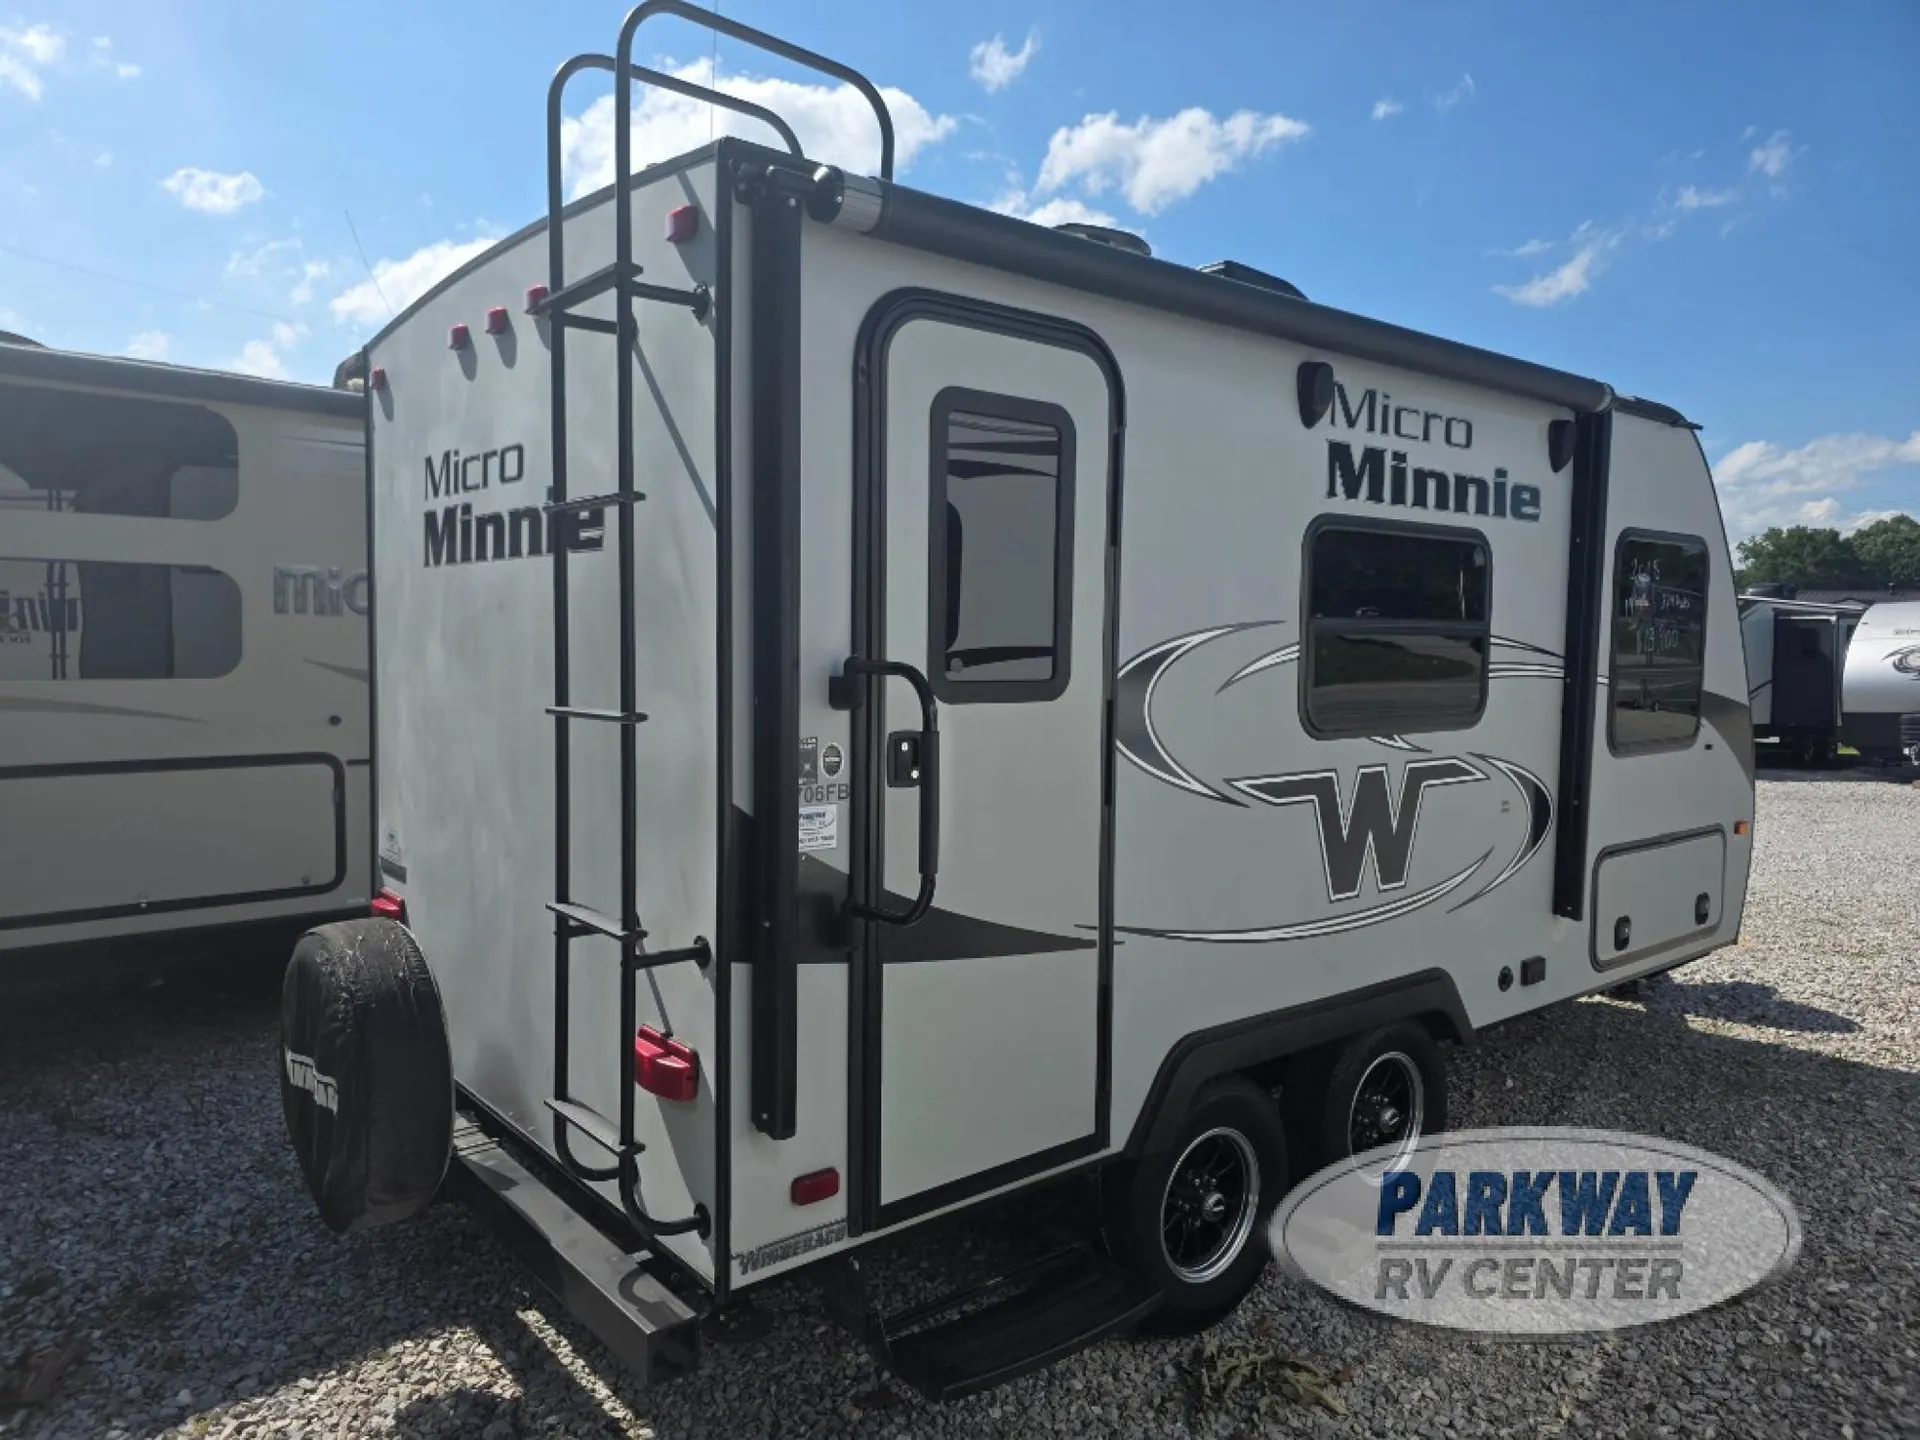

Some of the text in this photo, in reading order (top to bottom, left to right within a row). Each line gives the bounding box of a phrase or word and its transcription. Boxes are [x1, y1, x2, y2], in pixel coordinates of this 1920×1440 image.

[1330, 380, 1473, 449] Micro
[424, 442, 524, 500] Micro
[1325, 438, 1541, 522] Minnie
[1223, 756, 1491, 903] W
